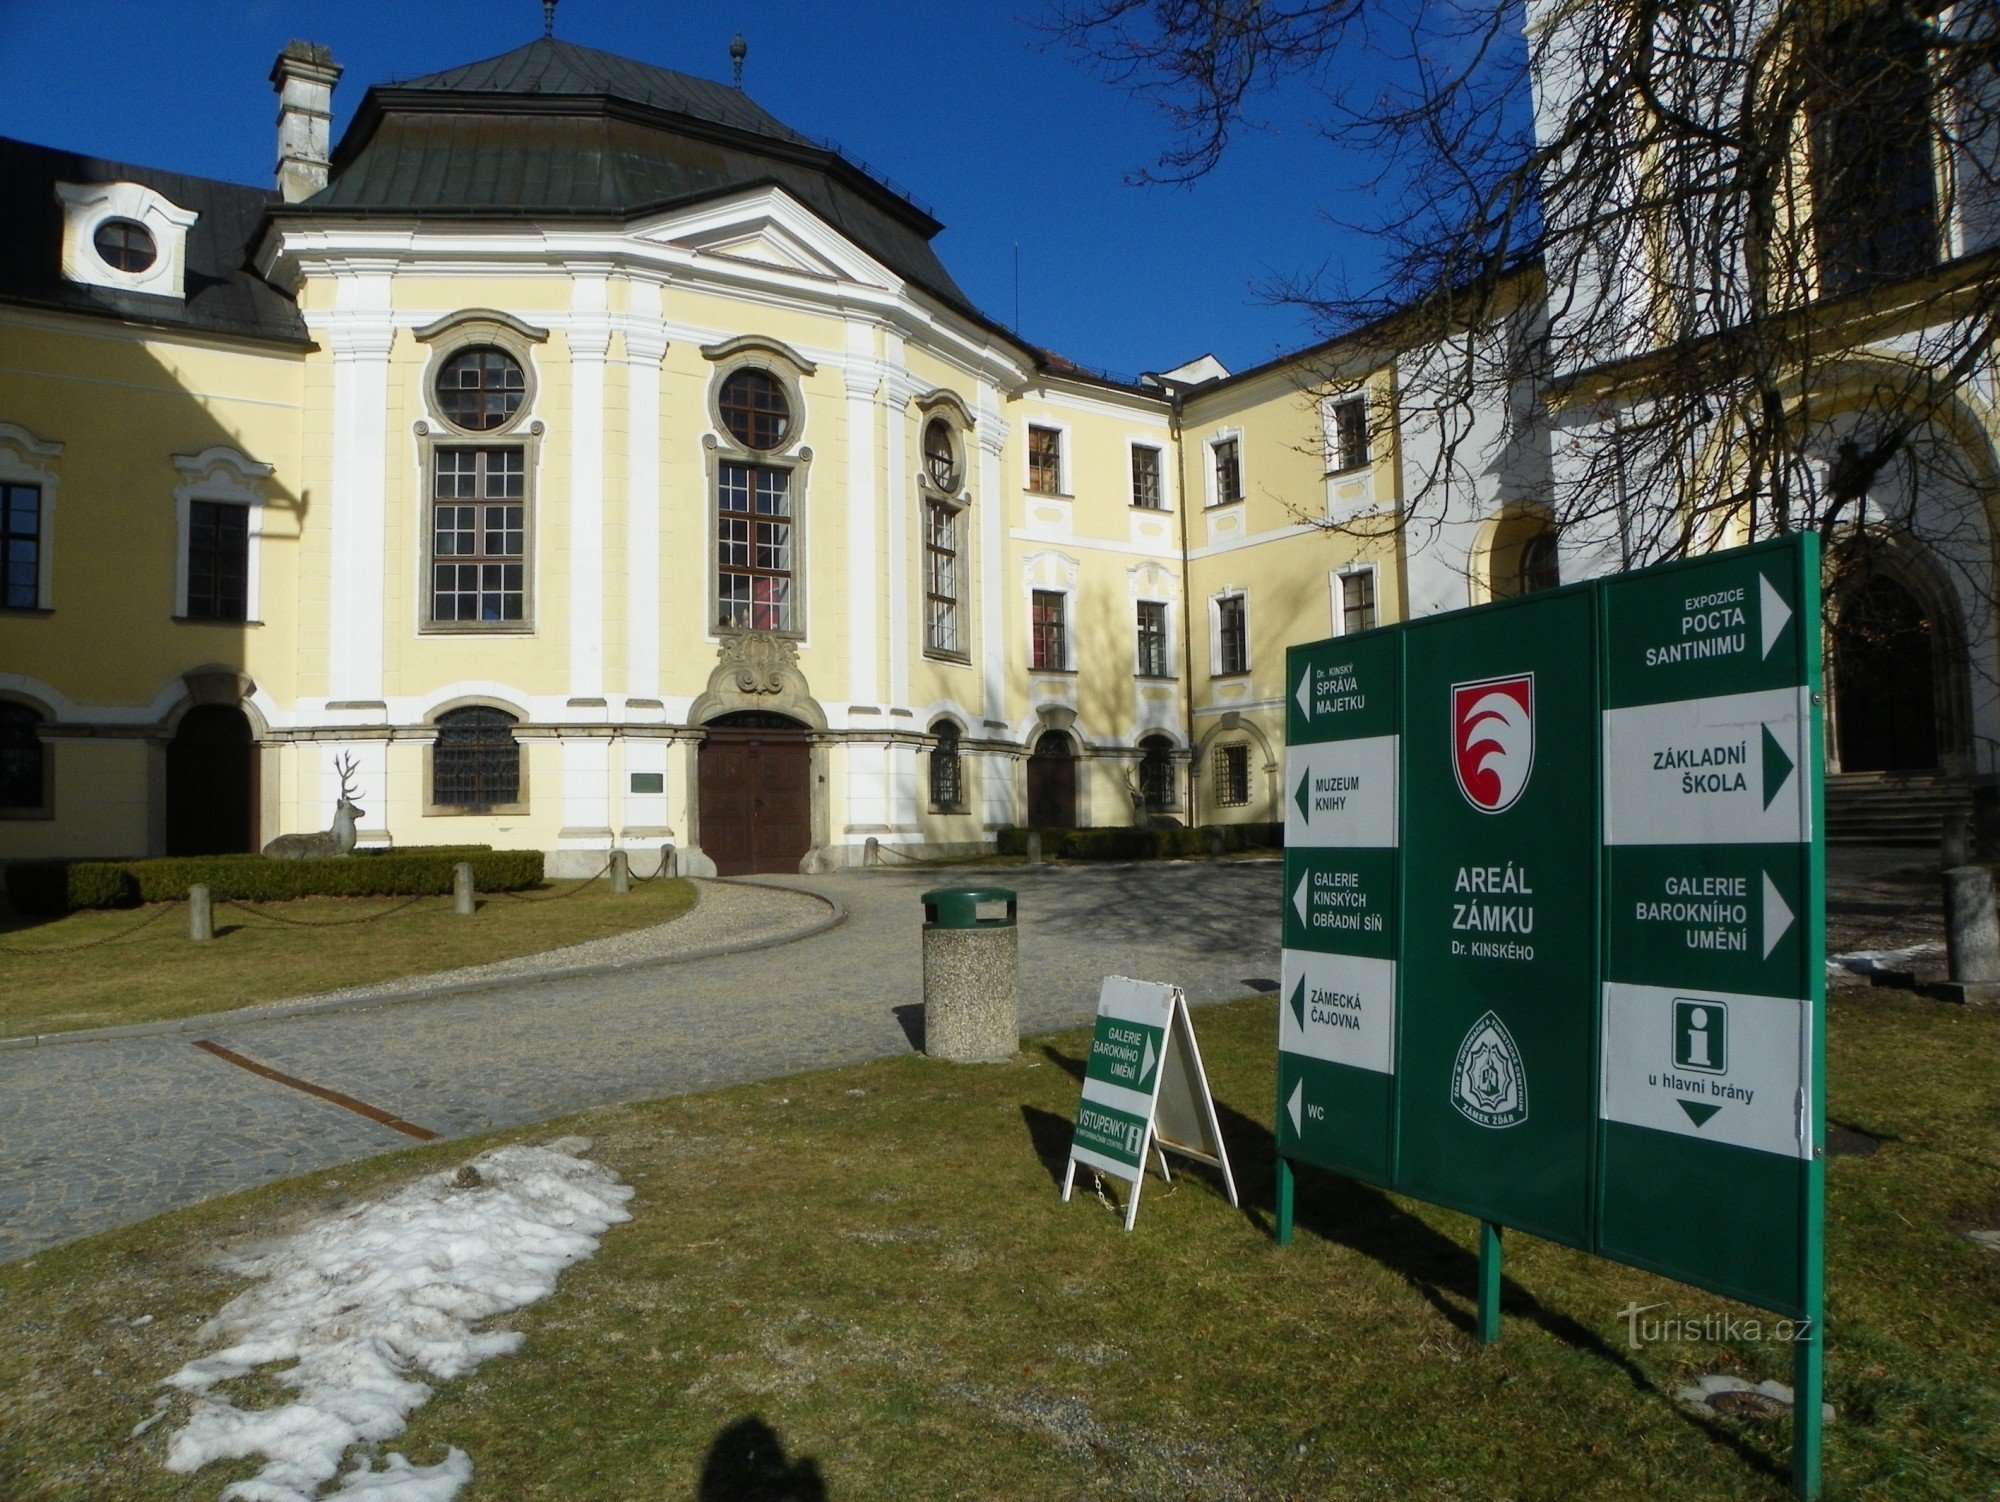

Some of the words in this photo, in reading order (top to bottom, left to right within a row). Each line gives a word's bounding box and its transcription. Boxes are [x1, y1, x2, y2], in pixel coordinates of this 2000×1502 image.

[1685, 588, 1745, 611] EXPOZICE
[1682, 607, 1746, 635] POCTA
[1646, 633, 1745, 666] SANTINIMU
[1328, 662, 1354, 677] KINSKÝ
[1317, 676, 1358, 695] SPRÁVA
[1317, 695, 1365, 714] MAJETKU
[1653, 741, 1746, 770] ZÁKLADNÍ
[1316, 776, 1359, 792] MUZEUM
[1682, 772, 1747, 794] ŠKOLA
[1316, 797, 1346, 811] KNIHY
[1314, 872, 1359, 887] GALERIE
[1455, 861, 1532, 894] AREÁL
[1665, 877, 1747, 896] GALERIE
[1314, 890, 1366, 908] KINSKÝCH
[1313, 911, 1360, 930] OBŘADNÍ
[1364, 914, 1382, 932] SÍŇ
[1452, 899, 1533, 934] ZÁMKU
[1636, 900, 1747, 924] BAROKNÍHO
[1686, 927, 1747, 951] UMĚNÍ
[1452, 940, 1467, 955] Dr.
[1471, 941, 1534, 961] KINSKÉHO
[1311, 988, 1361, 1011] ZÁMECKÁ
[1311, 1006, 1360, 1031] ČAJOVNA
[1108, 1027, 1142, 1046] GALERIE
[1093, 1041, 1139, 1062] BAROKNÍHO
[1110, 1062, 1136, 1080] UMĚNÍ
[1649, 1074, 1657, 1086] u
[1711, 1081, 1754, 1105] brány
[1307, 1103, 1324, 1120] WC
[1079, 1109, 1127, 1139] VSTUPENKY
